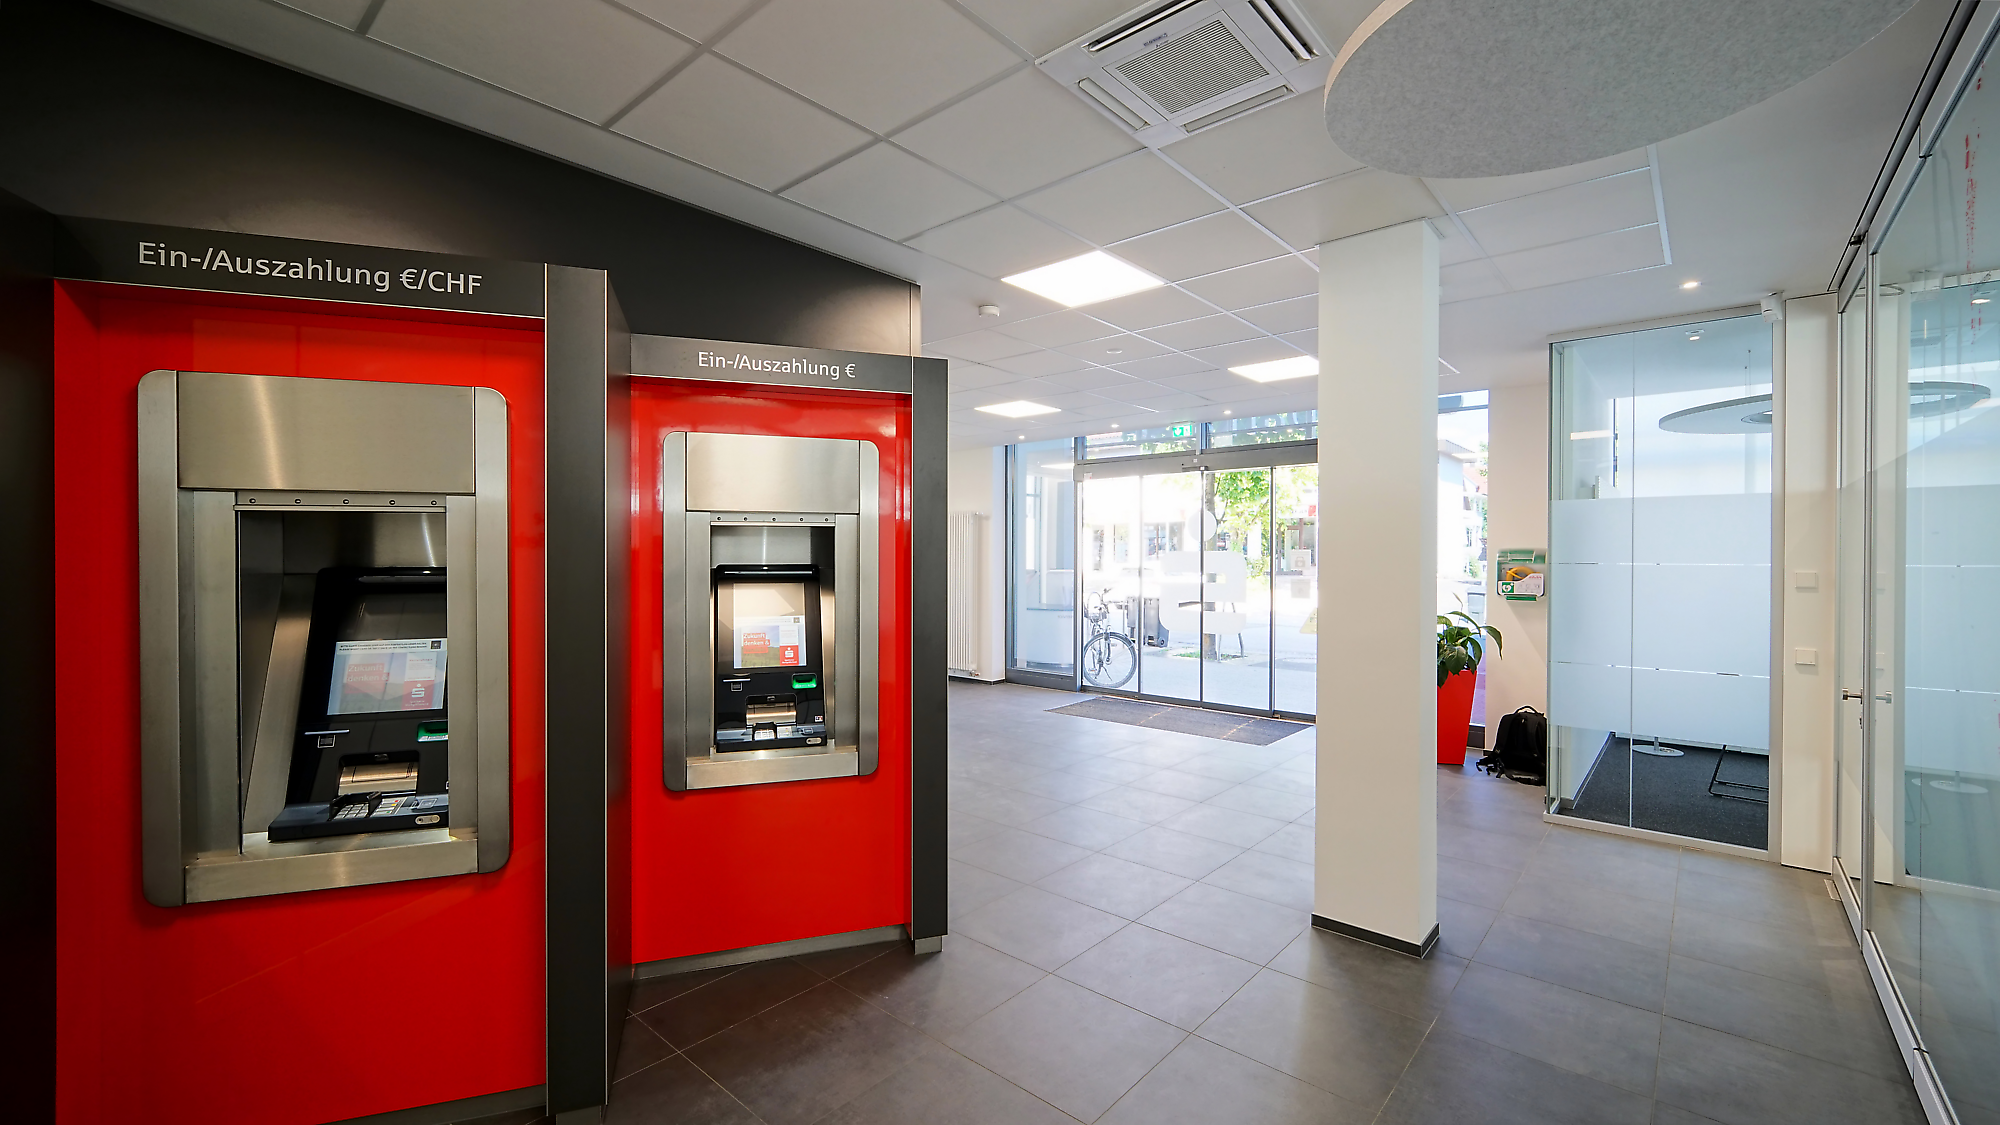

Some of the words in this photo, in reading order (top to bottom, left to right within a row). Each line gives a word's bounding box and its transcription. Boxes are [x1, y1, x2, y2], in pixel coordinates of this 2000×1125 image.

[138, 241, 391, 292] Ein-/Auszahlung
[400, 268, 483, 295] €/CHF
[697, 351, 841, 380] Ein-/Auszahlung
[844, 363, 857, 379] €
[348, 664, 383, 672] Zukunft
[347, 674, 380, 682] denken
